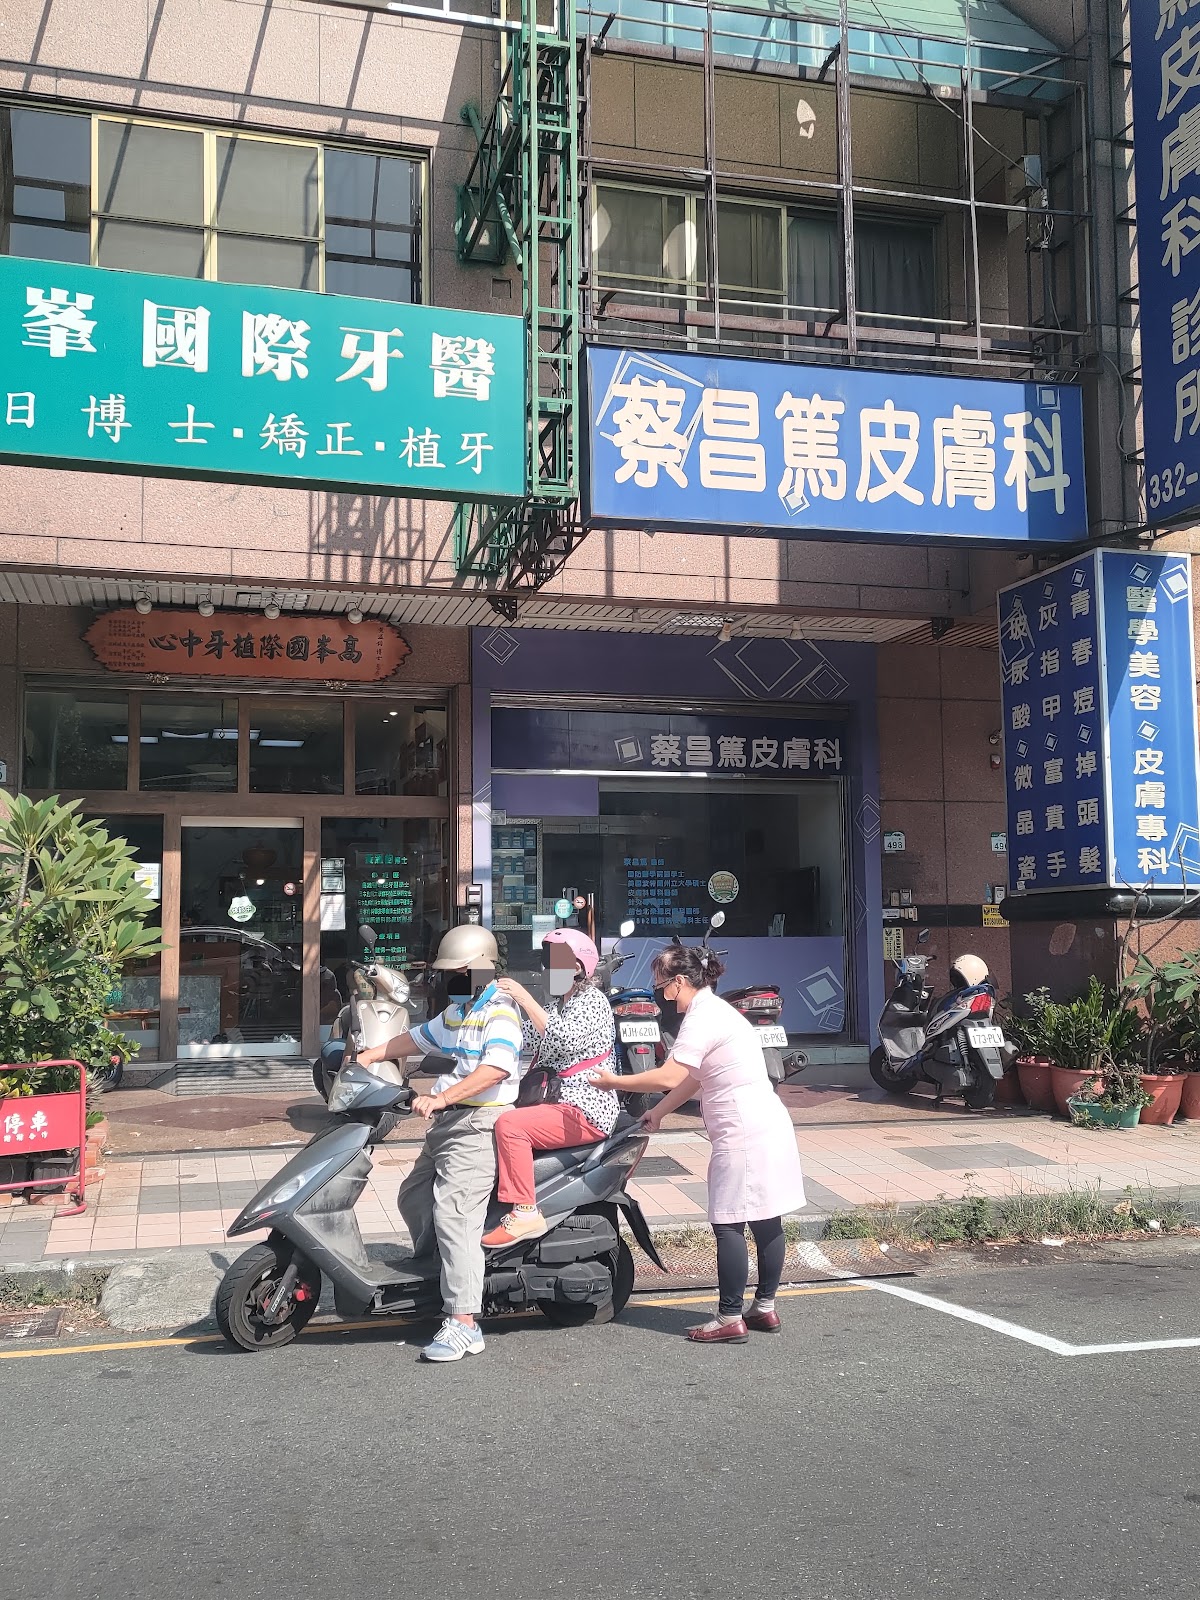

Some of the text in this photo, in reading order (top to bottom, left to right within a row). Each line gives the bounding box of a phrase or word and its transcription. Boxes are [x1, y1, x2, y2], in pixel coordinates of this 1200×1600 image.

[611, 376, 1071, 515] 蔡昌篤皮膚科
[649, 733, 844, 771] 蔡昌篤皮膚科
[1038, 601, 1067, 879] 灰指甲 富貴手
[1069, 589, 1102, 875] 青春痘 掉頭髮
[1126, 585, 1170, 875] 醫學美容 皮膚專科
[1013, 765, 1037, 882] 微晶瓷
[760, 1032, 787, 1046] 16-PKE
[3, 1110, 49, 1135] 停車
